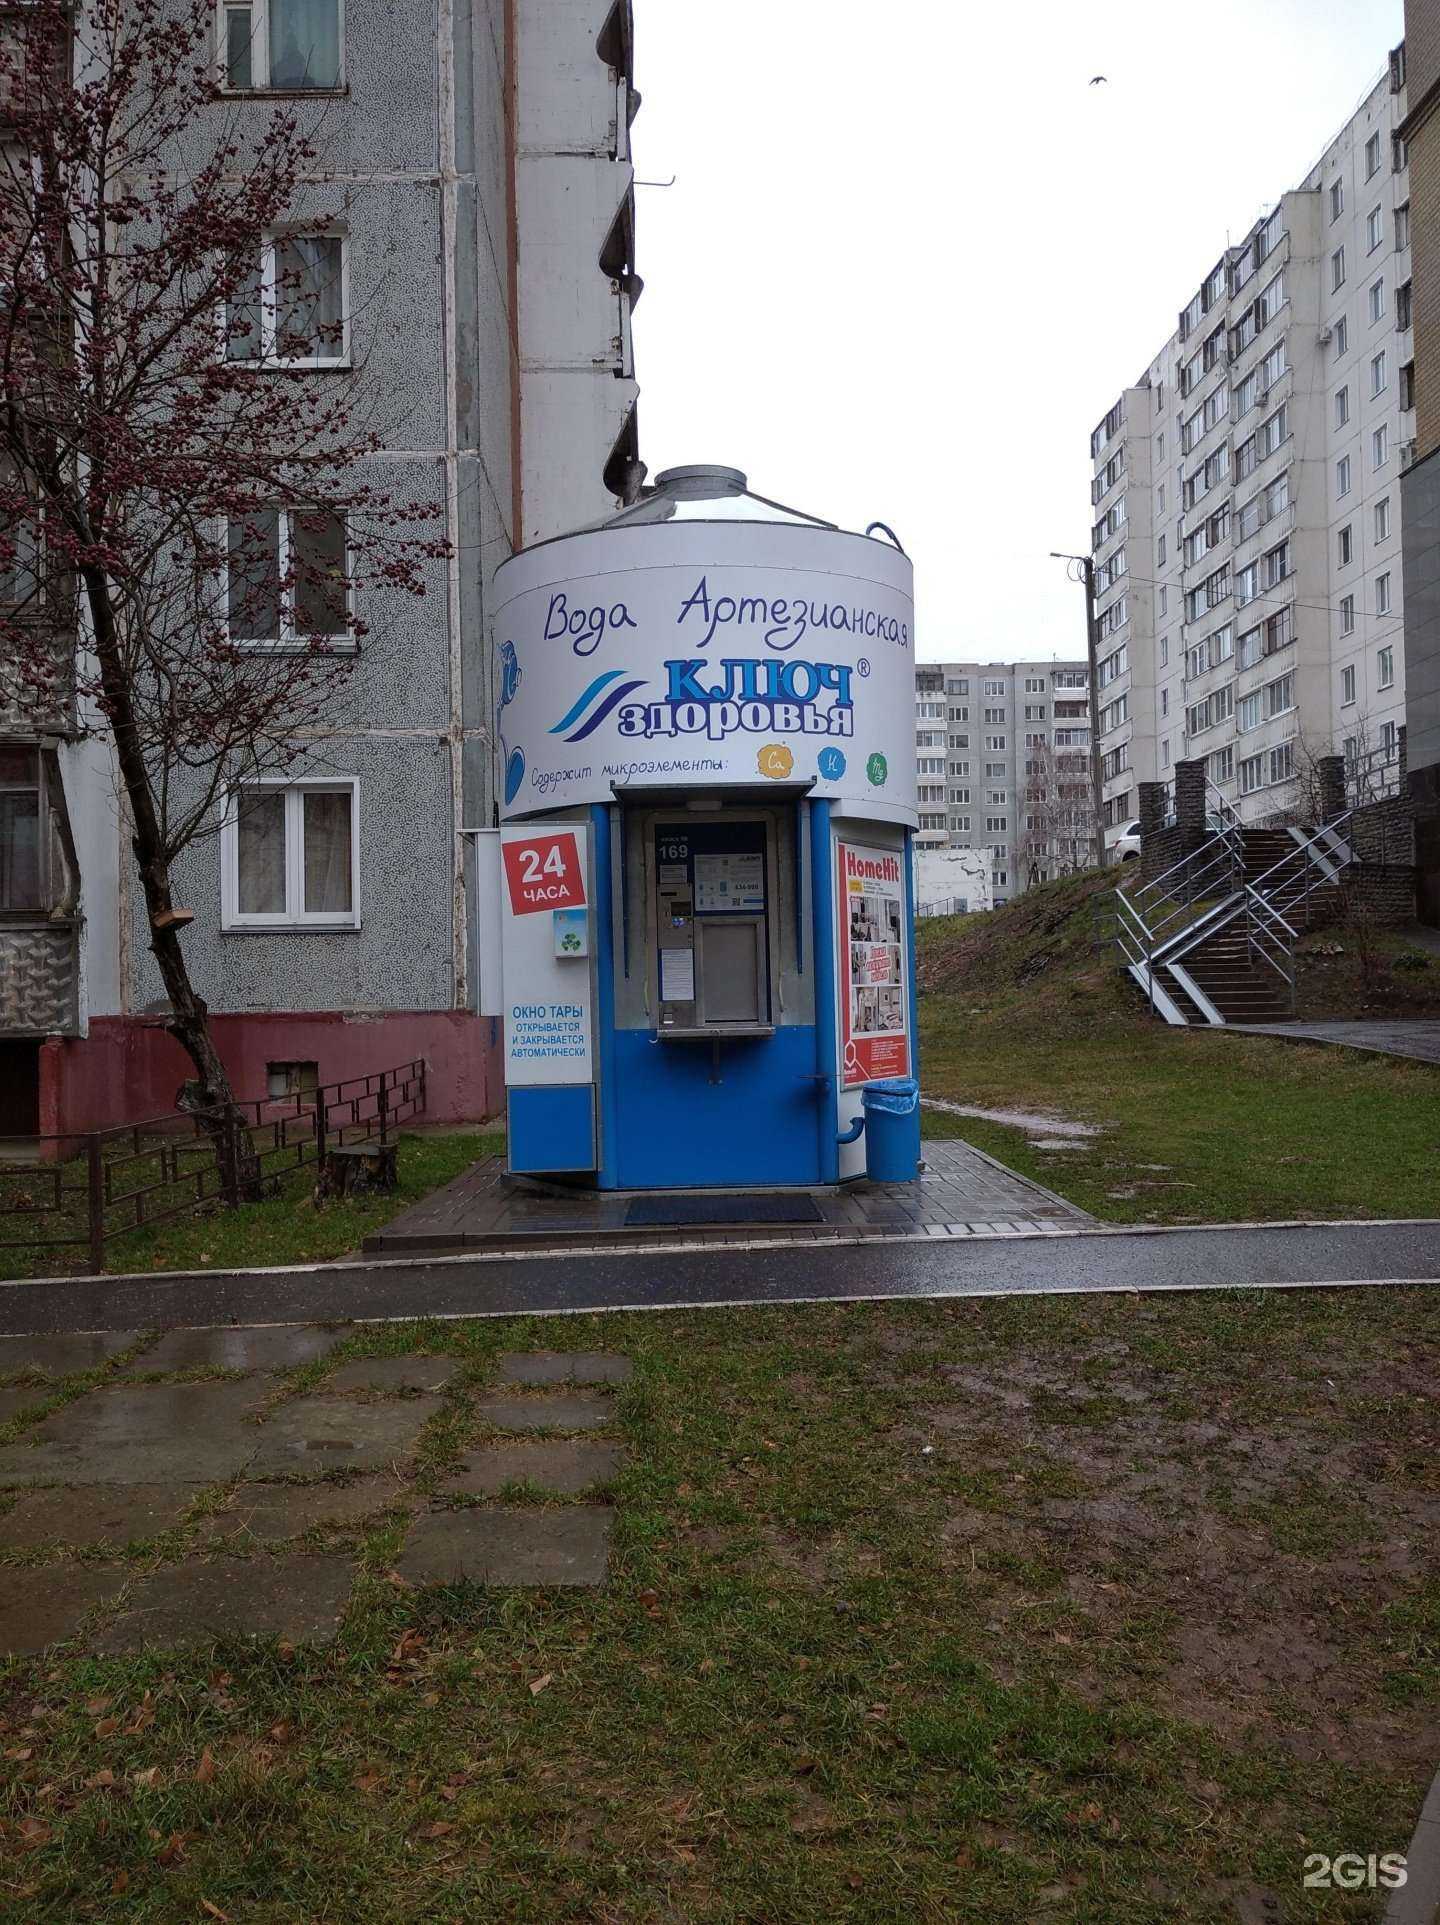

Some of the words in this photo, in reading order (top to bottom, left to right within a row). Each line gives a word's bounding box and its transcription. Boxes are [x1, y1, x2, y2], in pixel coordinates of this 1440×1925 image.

[543, 592, 637, 656] Вода
[677, 576, 908, 650] Артезианская
[531, 766, 592, 793] Содержит
[659, 844, 688, 859] 169
[518, 845, 567, 884] 24
[523, 884, 570, 902] ЧАСА
[512, 1006, 546, 1019] ОКНО
[550, 1005, 583, 1018] ТАРЫ
[516, 1022, 580, 1033] ОТКРЫВАЕТСЯ
[512, 1035, 519, 1045] И
[520, 1034, 584, 1045] ЗАКРЫВАЕТСЯ
[511, 1047, 585, 1058] АВТОМАТИЧЕСКИ
